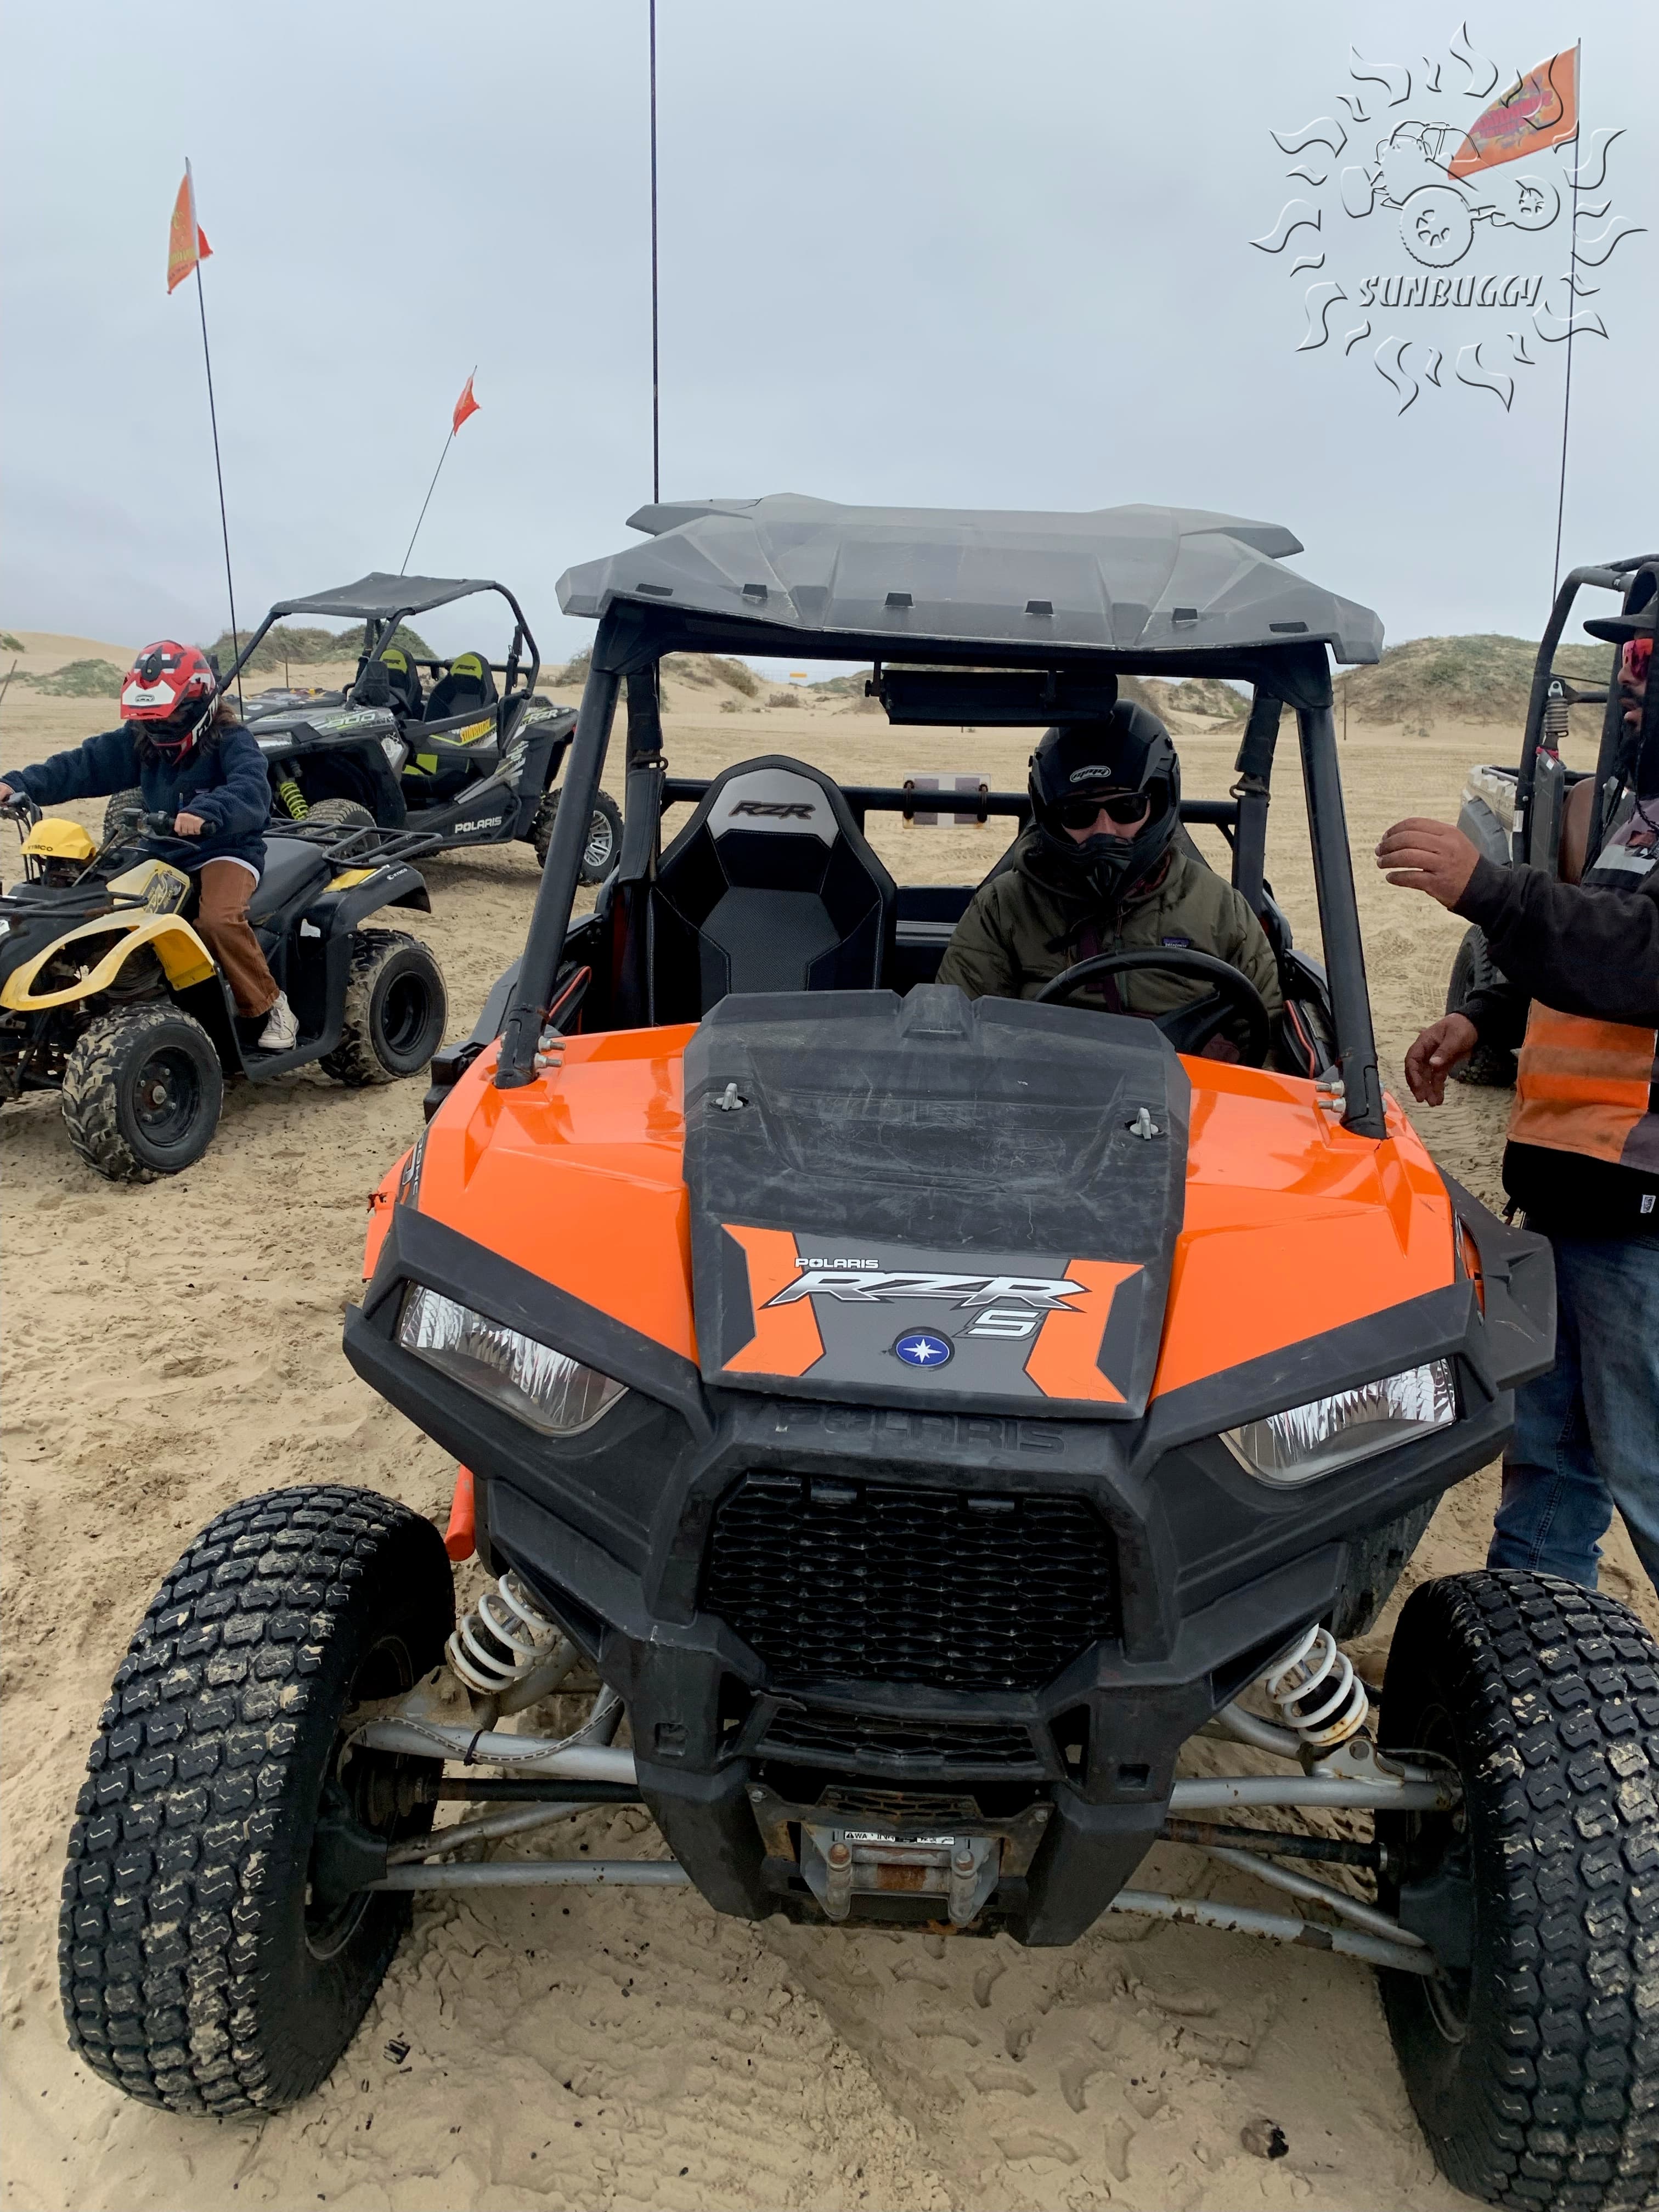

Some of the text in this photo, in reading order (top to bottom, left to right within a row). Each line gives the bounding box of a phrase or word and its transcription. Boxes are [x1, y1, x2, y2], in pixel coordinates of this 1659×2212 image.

[328, 714, 375, 728] 900
[529, 709, 558, 723] RZR
[729, 800, 816, 820] RZR
[454, 816, 502, 833] POLARIS
[794, 1257, 879, 1269] POLARIS
[759, 1270, 1090, 1312] RZR
[964, 1308, 1041, 1338] S
[775, 1403, 1068, 1454] POLARIS
